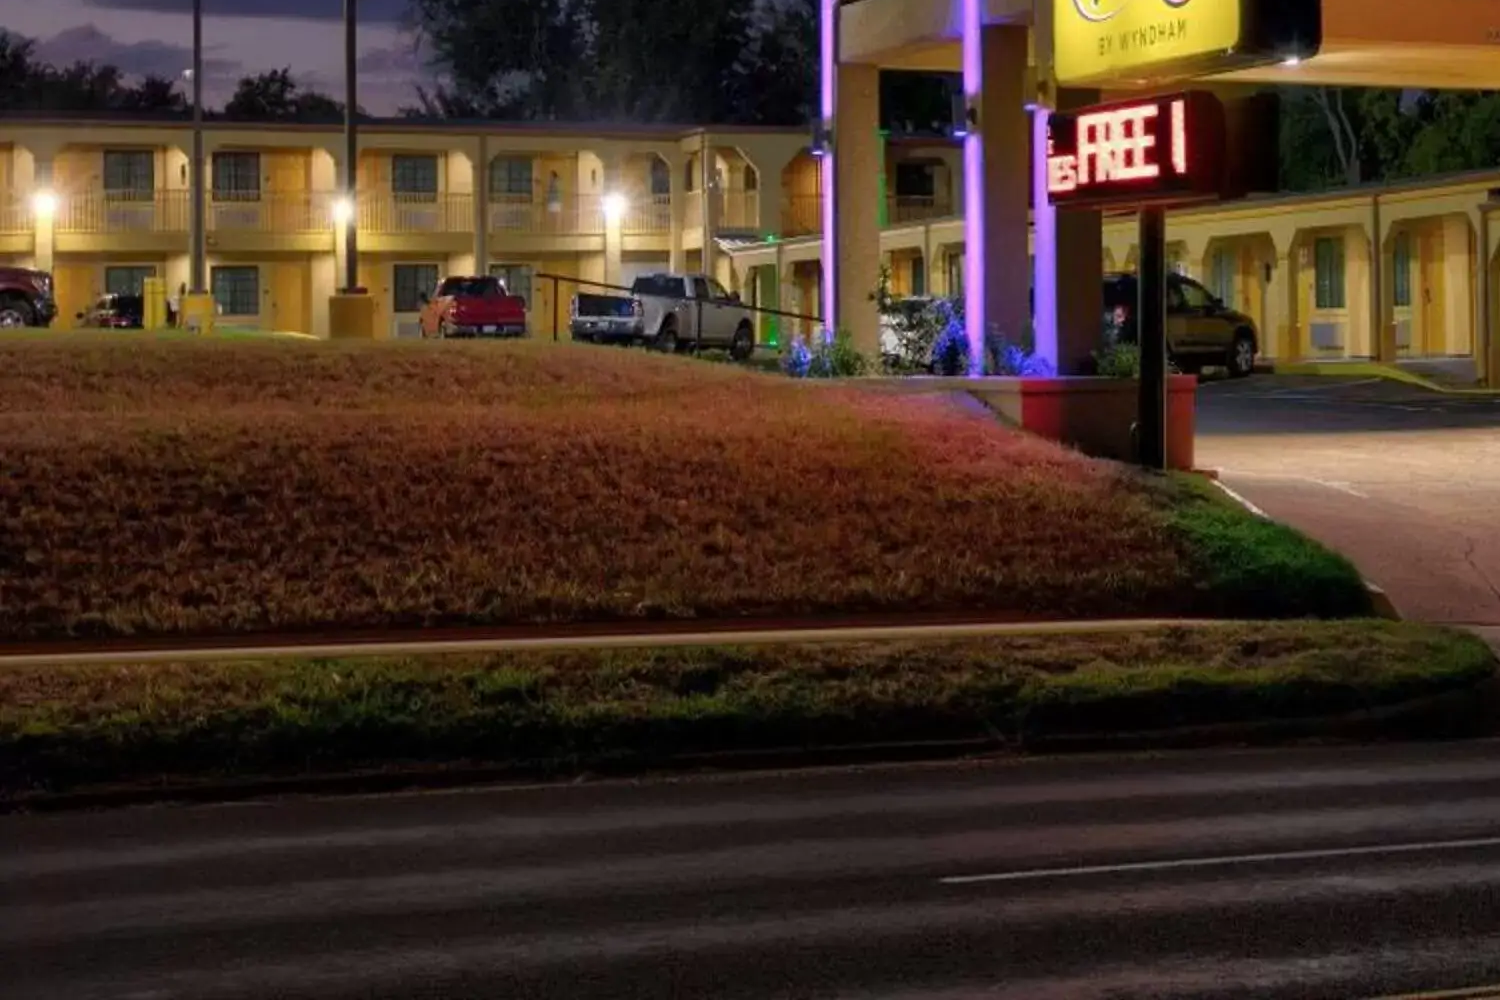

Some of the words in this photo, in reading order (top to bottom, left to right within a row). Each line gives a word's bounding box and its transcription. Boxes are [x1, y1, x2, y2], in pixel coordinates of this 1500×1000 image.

[1098, 34, 1112, 57] BY
[1119, 17, 1187, 52] WYNDHAM
[1077, 104, 1160, 184] FREE
